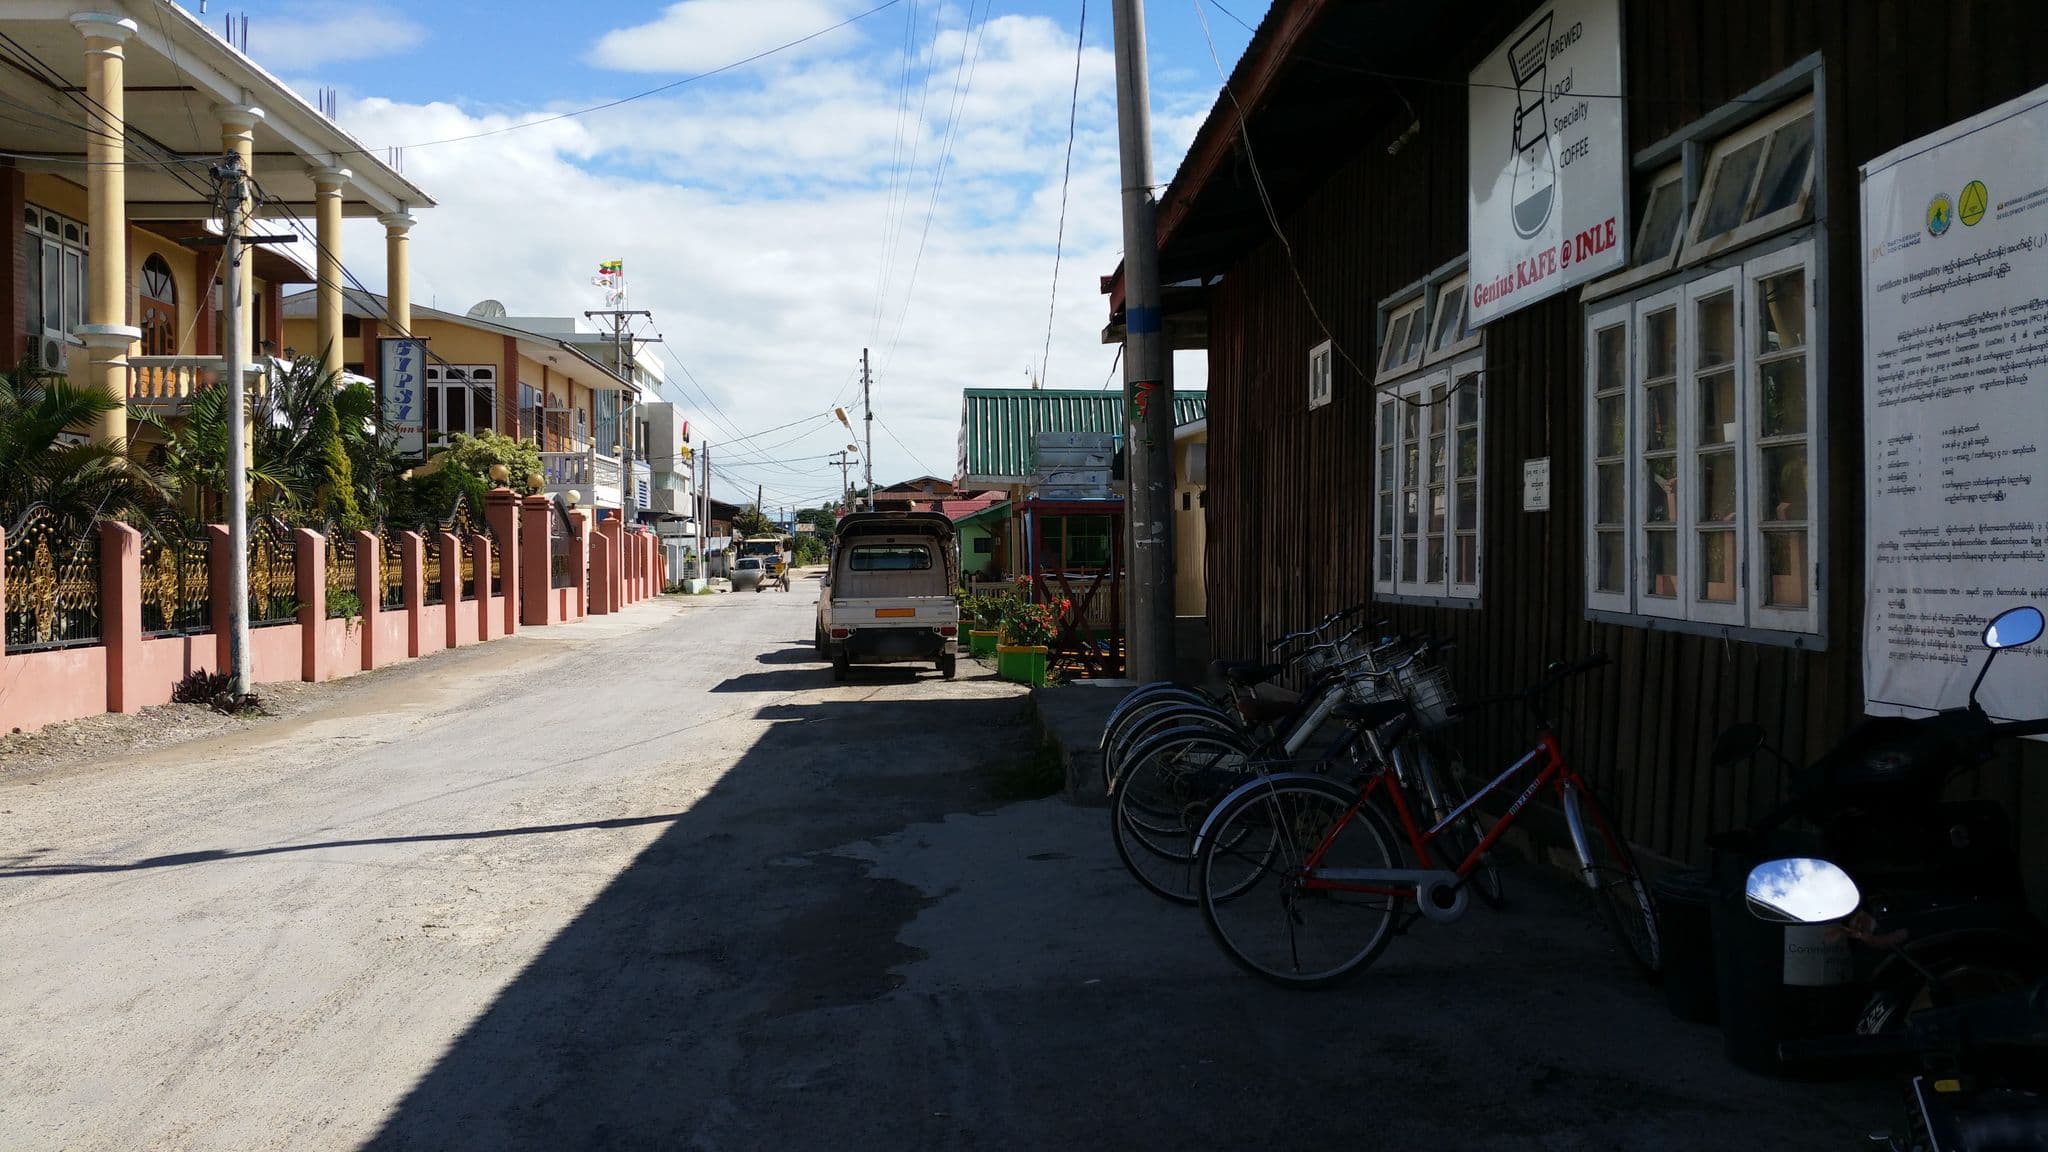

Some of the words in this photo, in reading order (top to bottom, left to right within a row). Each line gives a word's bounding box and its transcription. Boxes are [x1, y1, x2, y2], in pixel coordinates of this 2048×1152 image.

[1550, 21, 1582, 60] BREWED
[1550, 66, 1573, 103] Local
[1553, 101, 1588, 136] Specialty
[1559, 136, 1589, 169] COFFEE
[1474, 275, 1514, 308] Genius
[1516, 246, 1557, 290] KAFE
[1560, 239, 1572, 269] @
[1575, 216, 1617, 264] INLE
[1909, 266, 1940, 283] Hospitality
